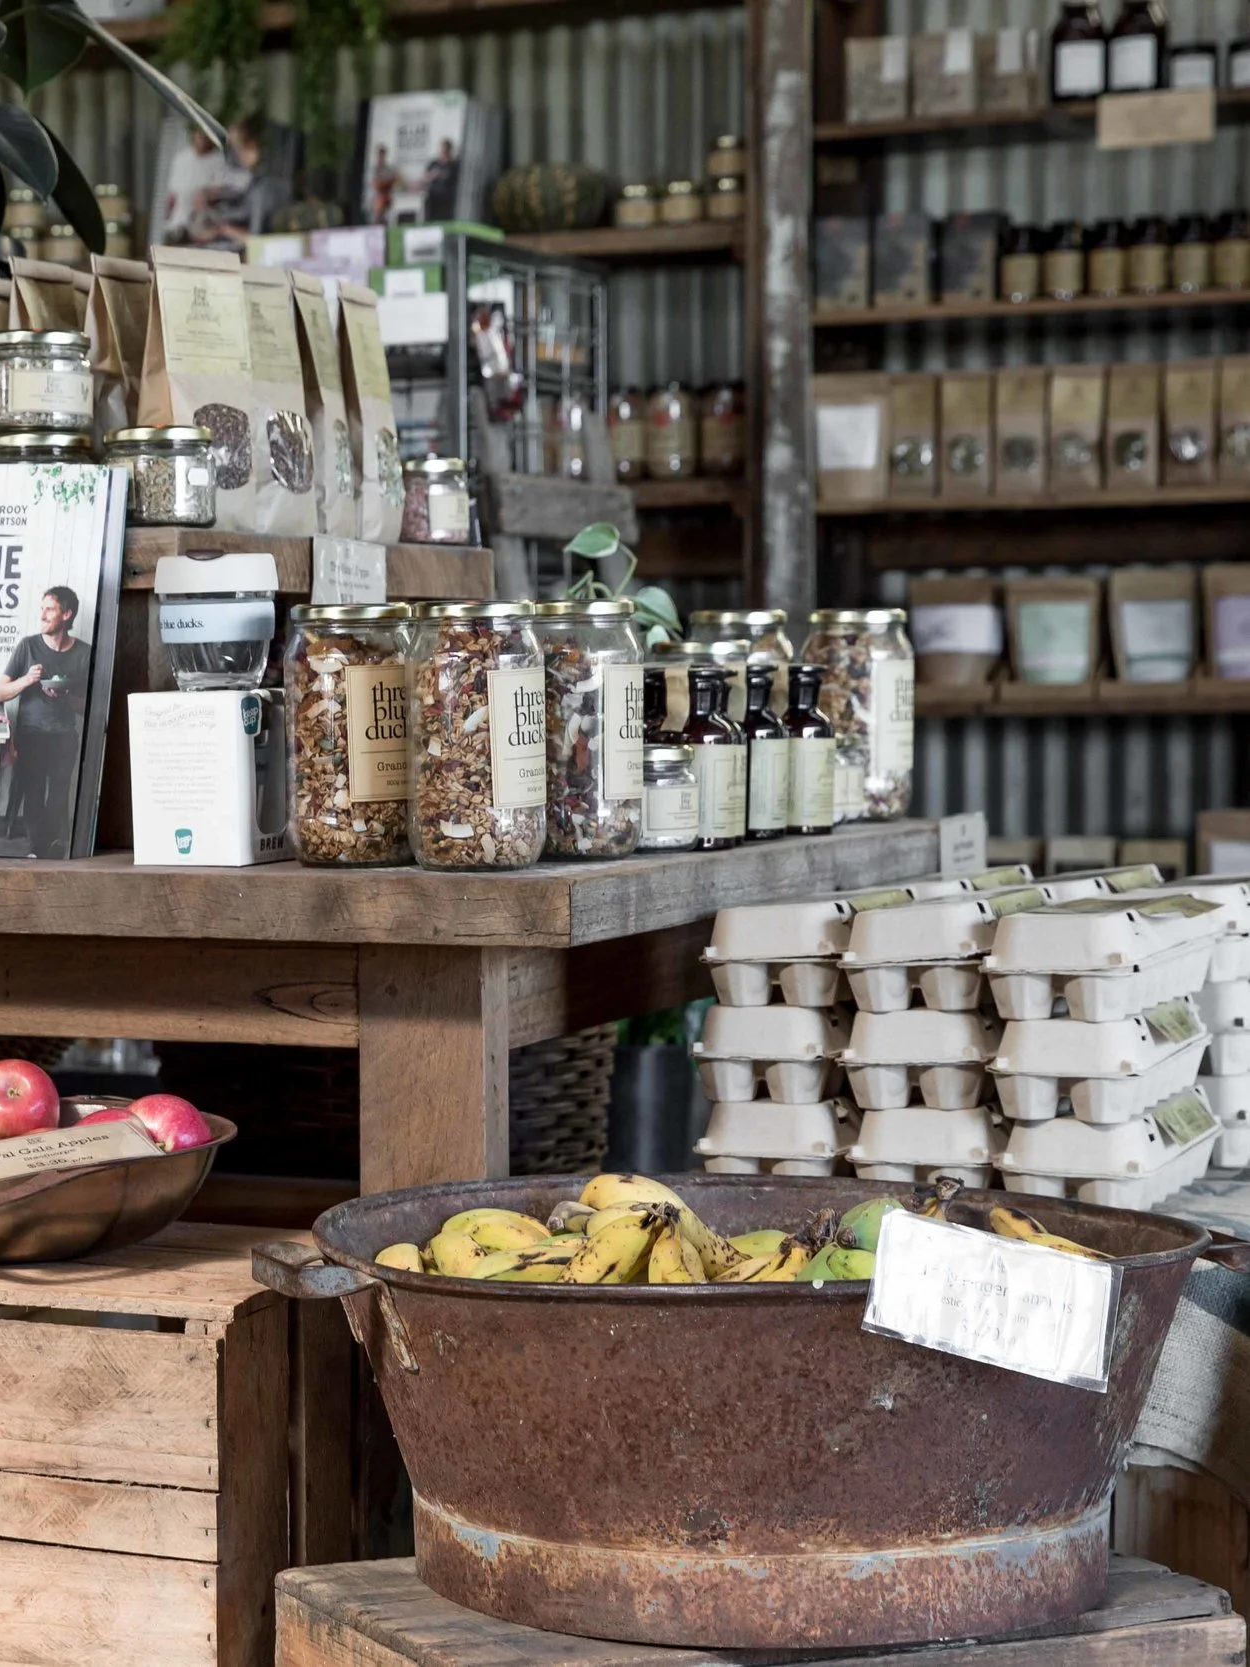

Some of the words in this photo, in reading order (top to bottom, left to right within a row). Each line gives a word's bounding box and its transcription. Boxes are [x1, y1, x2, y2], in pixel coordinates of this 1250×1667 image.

[177, 618, 205, 629] ducks.
[260, 836, 284, 851] BREW
[18, 1145, 53, 1156] Gala
[56, 1134, 110, 1149] Apples
